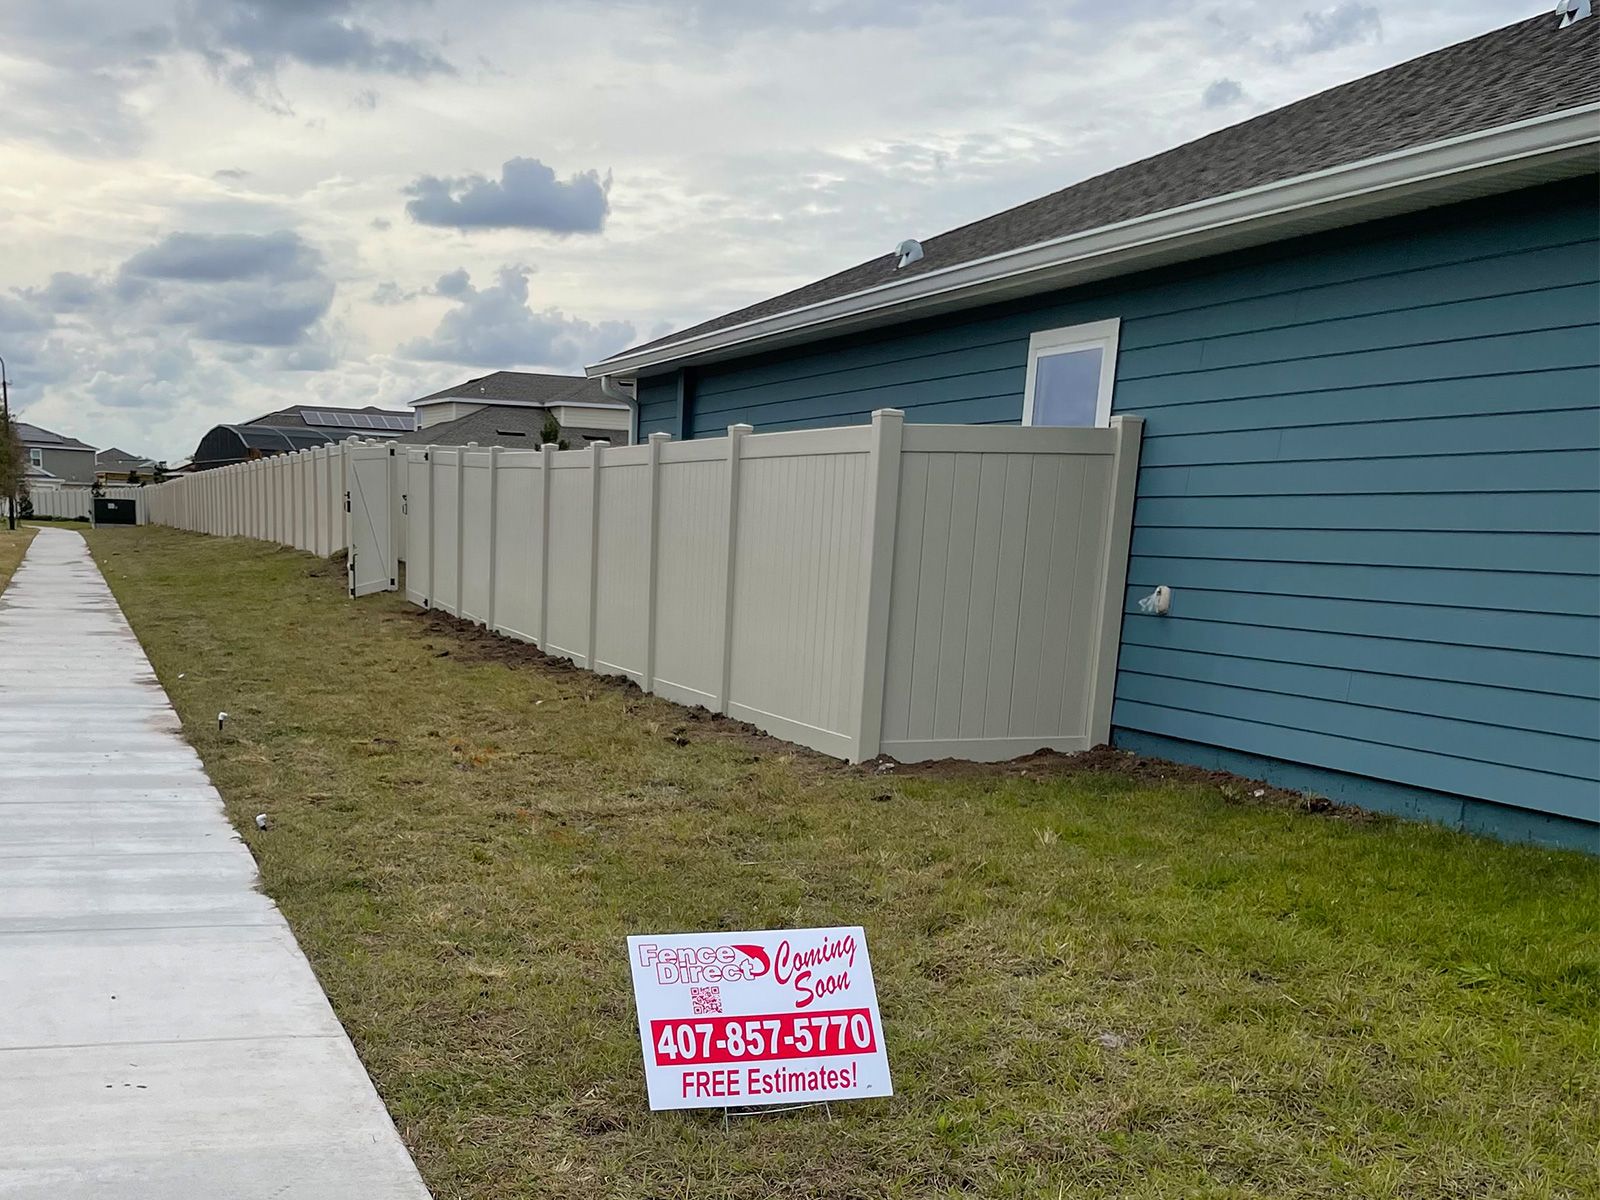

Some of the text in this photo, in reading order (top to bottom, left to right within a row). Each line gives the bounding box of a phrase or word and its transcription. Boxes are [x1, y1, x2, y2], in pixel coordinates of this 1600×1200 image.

[638, 944, 736, 967] Fence
[656, 958, 755, 985] Direct
[774, 934, 857, 985] Coming
[795, 971, 851, 1008] Soon
[657, 1014, 871, 1060] 407-857-5770
[682, 1062, 857, 1098] FREE Estimates!
